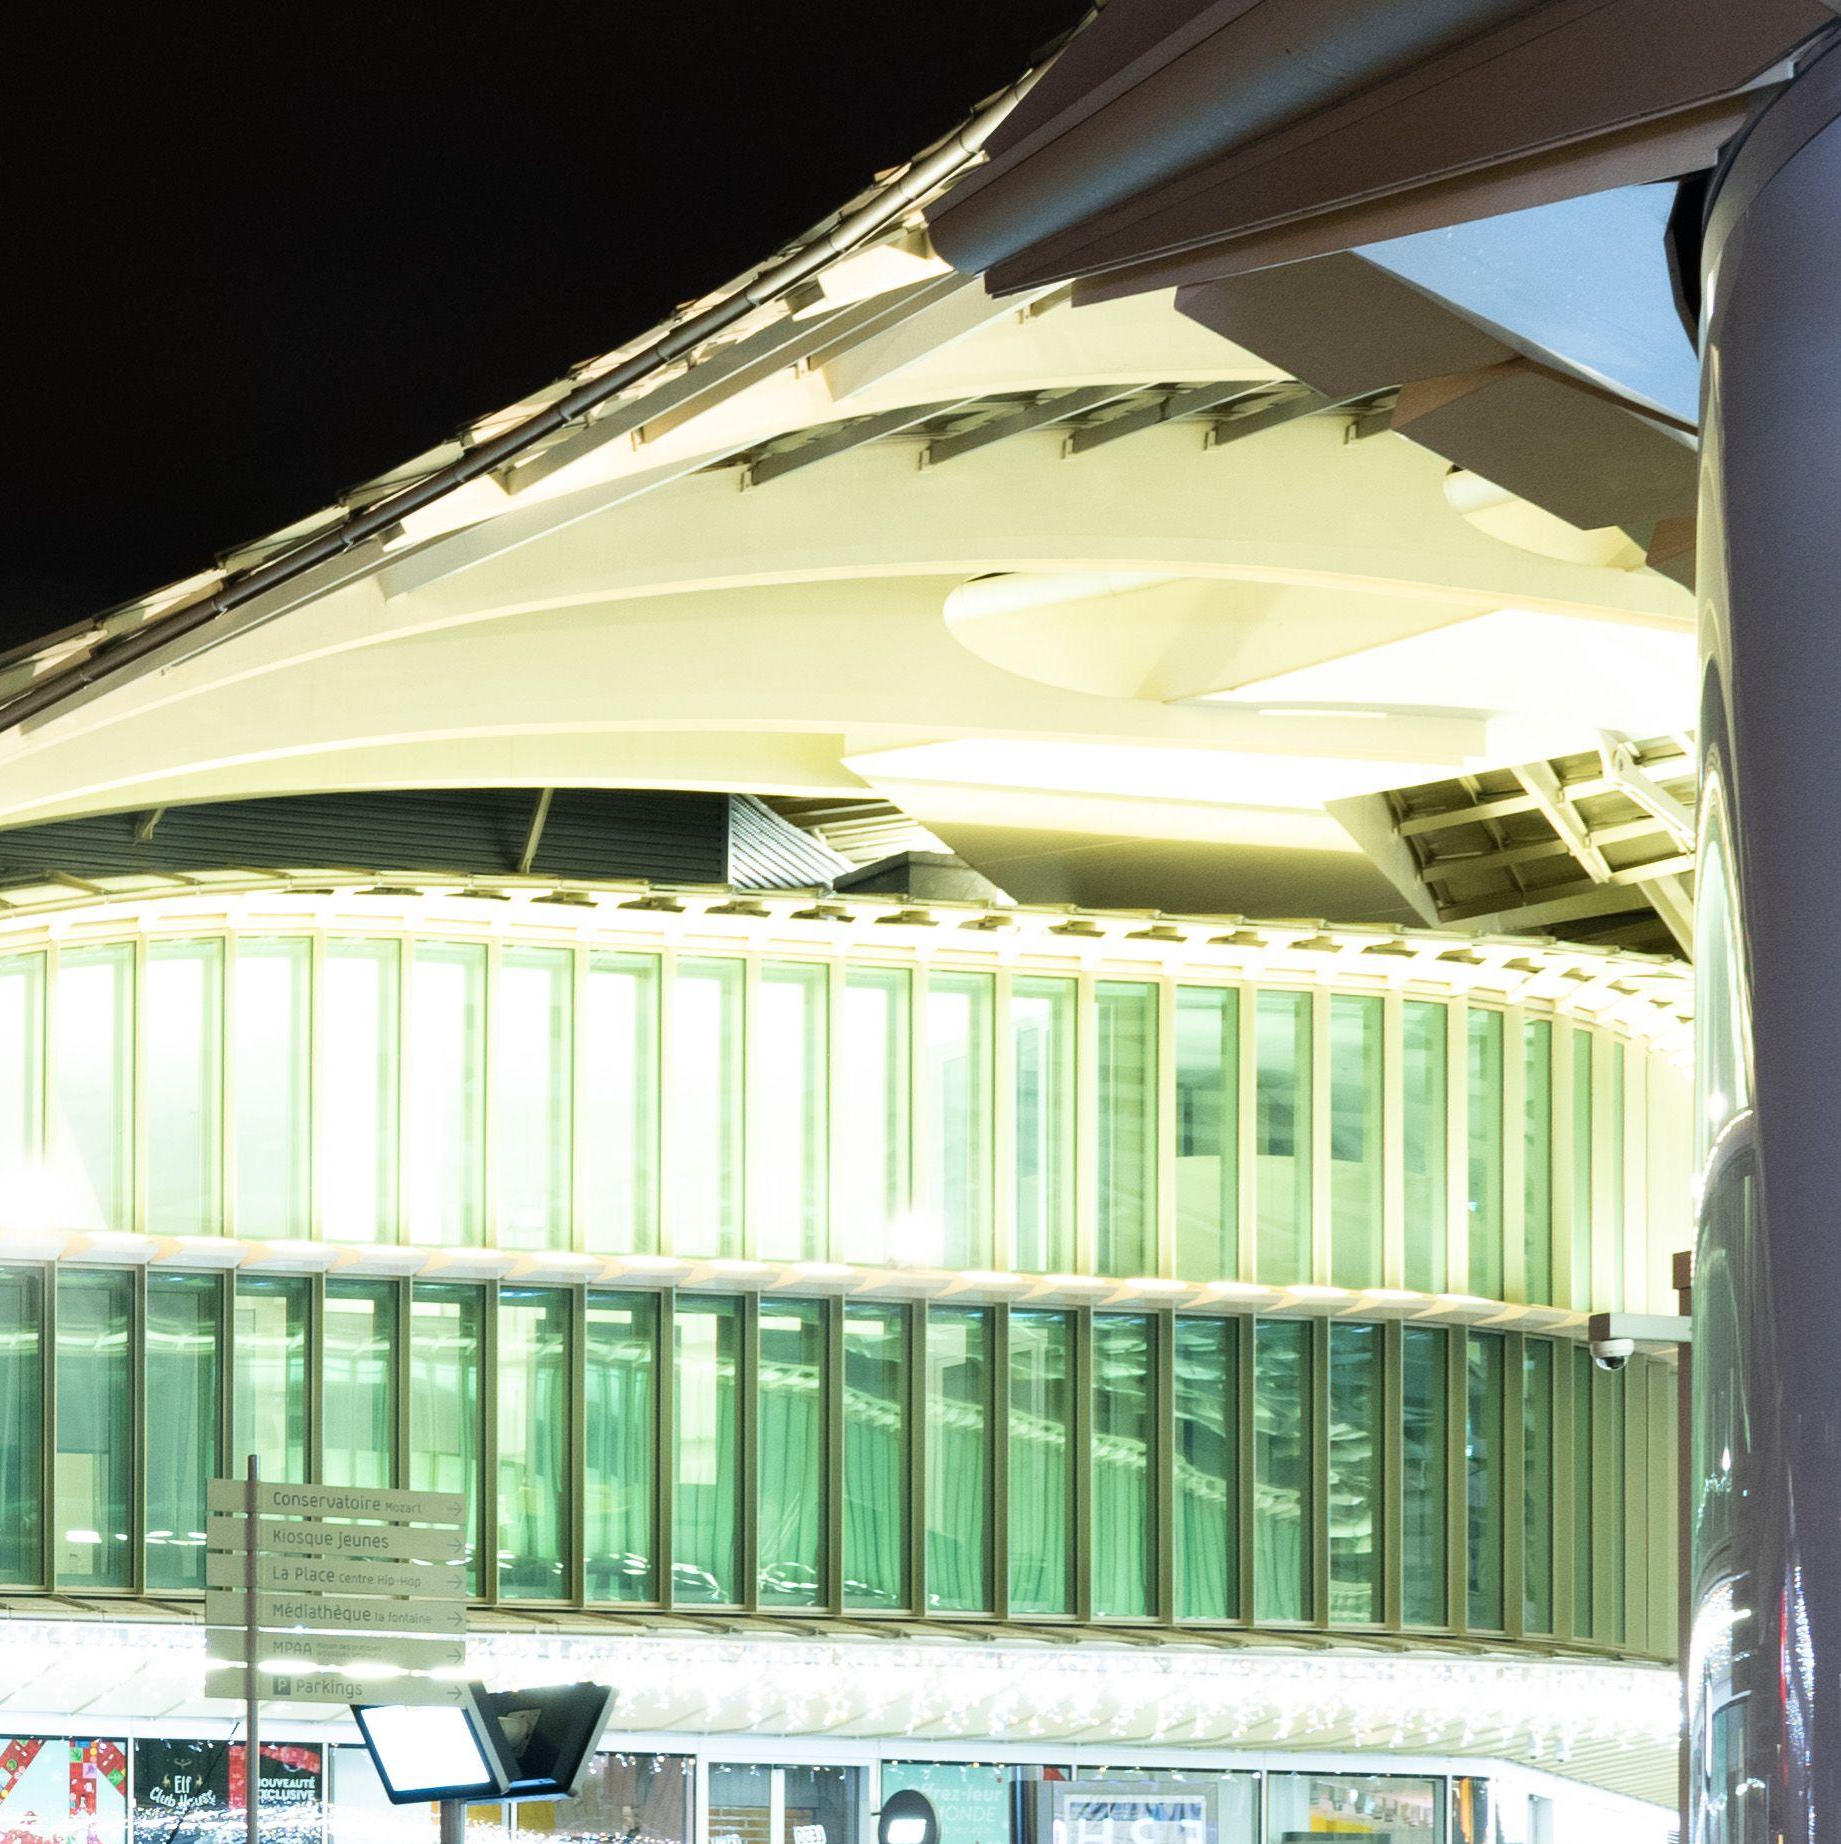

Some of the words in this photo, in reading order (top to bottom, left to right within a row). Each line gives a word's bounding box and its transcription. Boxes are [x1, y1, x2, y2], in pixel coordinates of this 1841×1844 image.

[273, 1491, 381, 1512] Conservatoire
[385, 1501, 422, 1513] Mozart
[273, 1529, 333, 1549] Kiosque
[336, 1531, 389, 1550] jeunes
[273, 1566, 289, 1581] La
[295, 1567, 335, 1583] Place
[273, 1602, 372, 1622] Médiathèque
[273, 1641, 312, 1655] MPAA
[296, 1678, 363, 1699] Parkings
[174, 1775, 192, 1794] Elf
[149, 1786, 177, 1807] Club
[258, 1789, 315, 1801] XCLUSIVE
